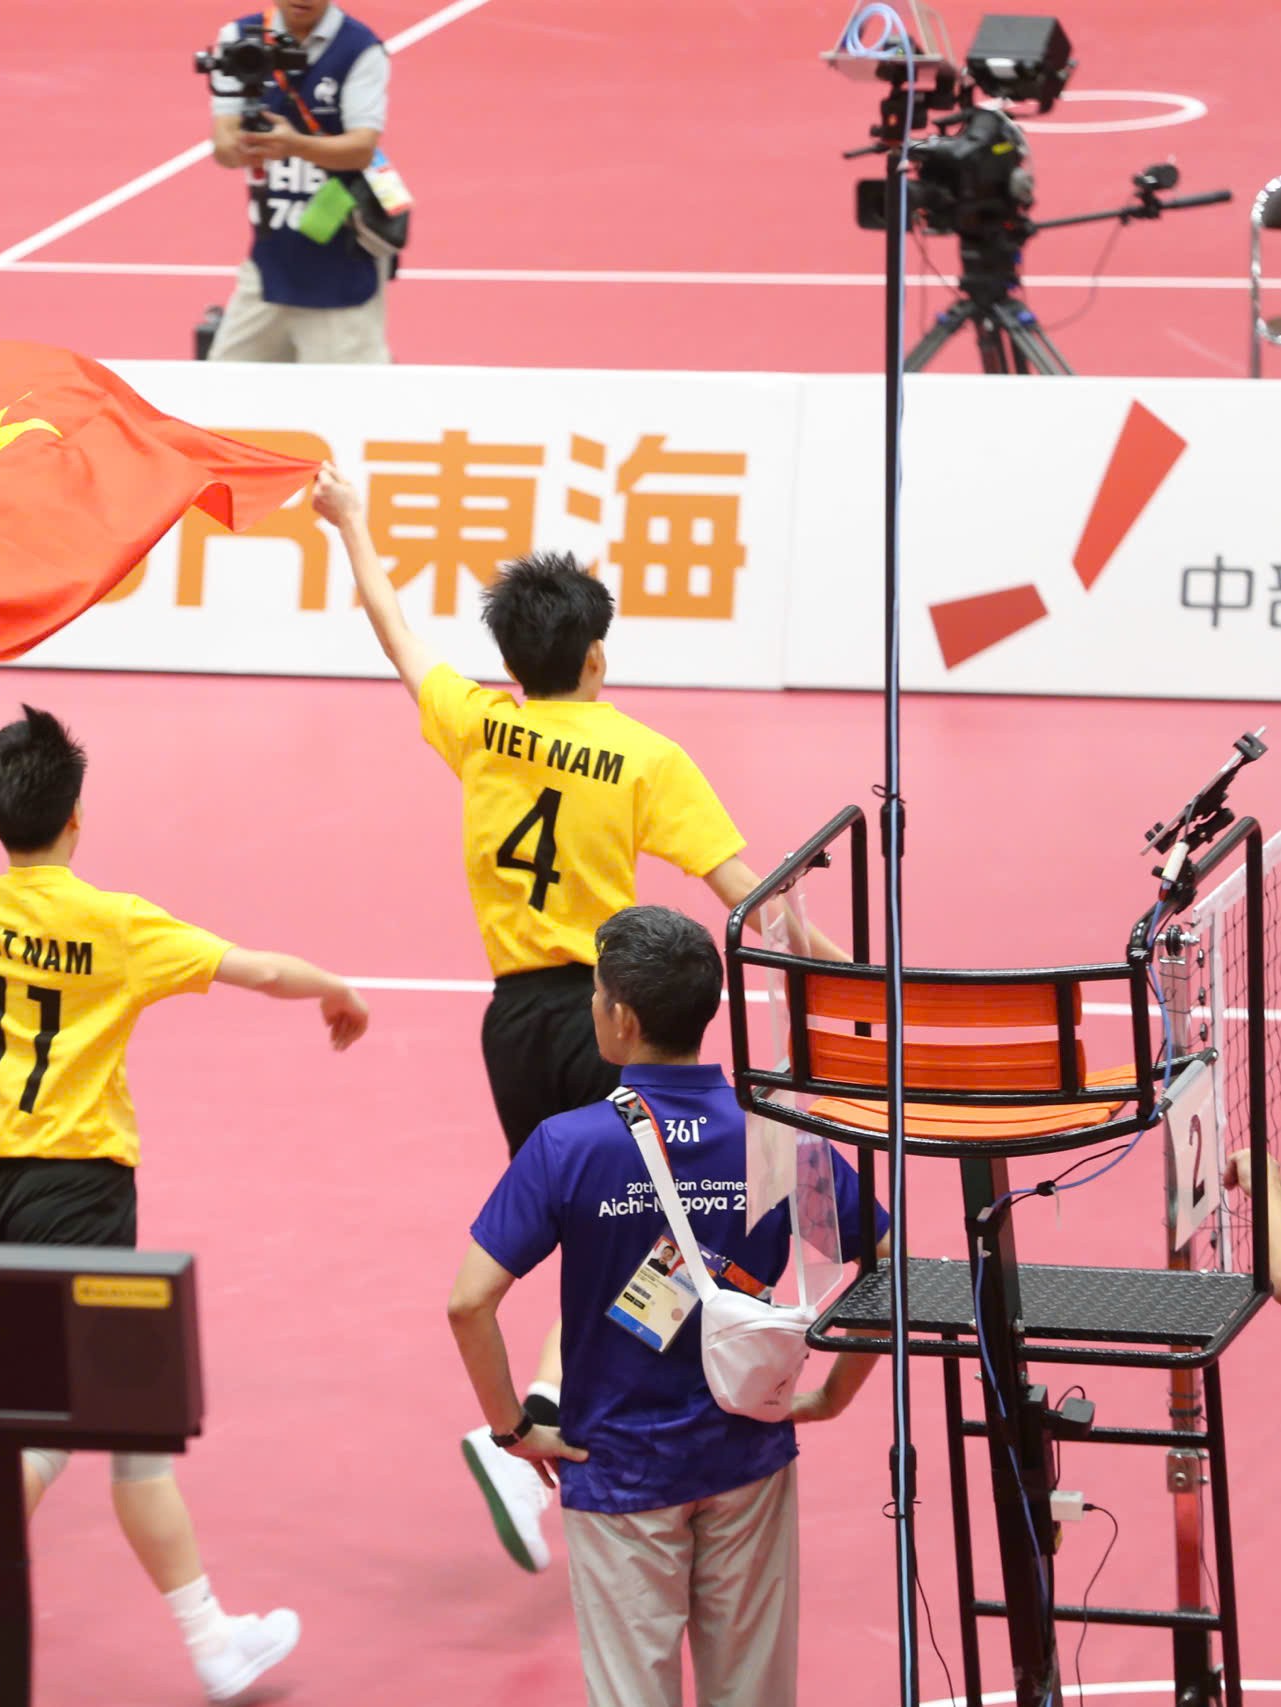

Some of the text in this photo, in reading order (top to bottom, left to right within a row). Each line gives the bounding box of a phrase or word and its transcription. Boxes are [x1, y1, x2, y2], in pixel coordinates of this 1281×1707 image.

[101, 429, 748, 620] R東海
[1179, 555, 1281, 627] 中
[483, 717, 625, 785] VIET NAM
[496, 786, 562, 913] 4
[22, 934, 93, 976] NAM
[1188, 1113, 1206, 1208] 2
[598, 1194, 728, 1217] Aichi-Ngoya
